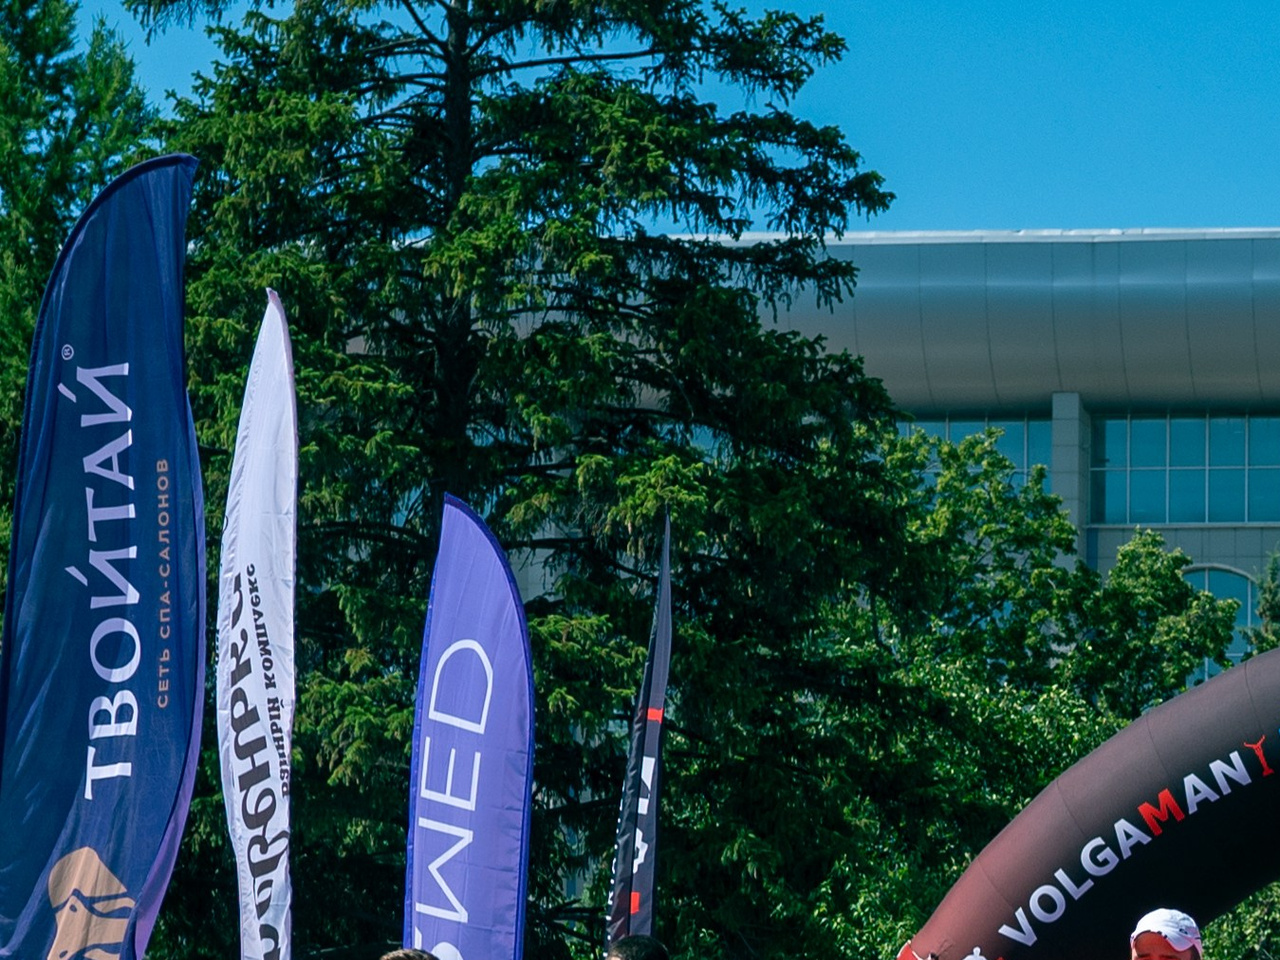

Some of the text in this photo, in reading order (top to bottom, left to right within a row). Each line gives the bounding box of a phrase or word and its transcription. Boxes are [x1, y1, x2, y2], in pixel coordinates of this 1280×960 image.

[58, 361, 141, 800] ТВОЙТАЙ
[156, 458, 171, 709] СЕТЬ СПА-САЛОНОВ
